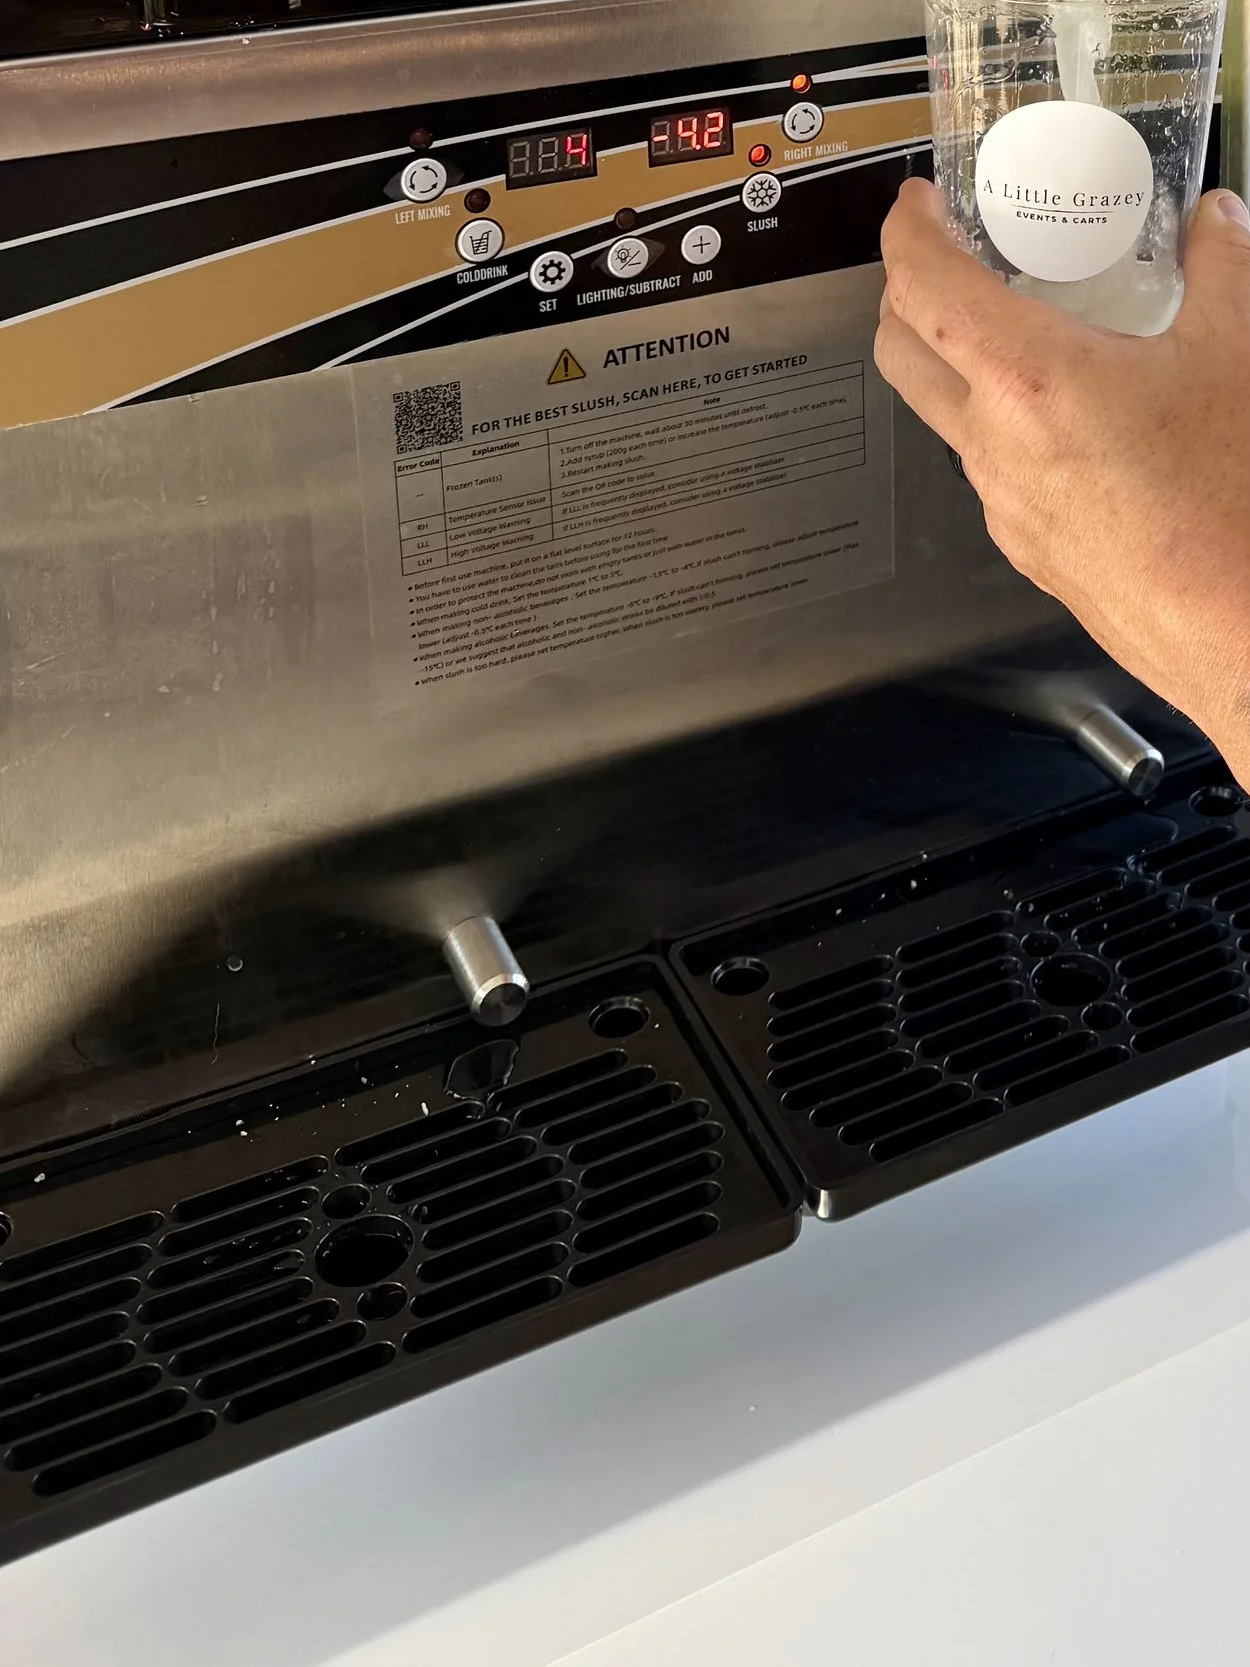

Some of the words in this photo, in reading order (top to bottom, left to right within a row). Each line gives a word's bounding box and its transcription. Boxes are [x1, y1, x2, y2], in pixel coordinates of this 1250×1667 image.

[783, 147, 813, 162] RIGHT
[814, 140, 849, 157] MIXING
[983, 179, 994, 194] A
[1002, 183, 1062, 206] Little
[1072, 191, 1145, 207] Grazey
[395, 209, 417, 225] LEFT
[417, 204, 452, 222] MIXING
[1016, 210, 1058, 223] EVENTS
[1061, 216, 1069, 224] &
[1072, 216, 1108, 224] CARTS
[747, 216, 779, 233] SLUSH
[456, 264, 509, 285] COLDDRINK
[692, 269, 714, 284] ADD
[576, 275, 682, 306] LIGHTING/SUBTRACT
[538, 298, 558, 313] SET
[602, 325, 731, 369] ATTENTION
[471, 418, 501, 436] FOR
[503, 412, 532, 430] THE
[534, 404, 569, 423] BEST
[571, 394, 621, 415] SLUSH,
[622, 385, 660, 406] SCAN
[662, 377, 702, 397] HERE,
[703, 370, 723, 387] TO
[724, 365, 750, 382] GET
[751, 354, 809, 376] STARTED
[703, 397, 721, 406] Note
[472, 441, 520, 457] Explanation
[397, 463, 418, 473] Error
[419, 458, 440, 468] Code
